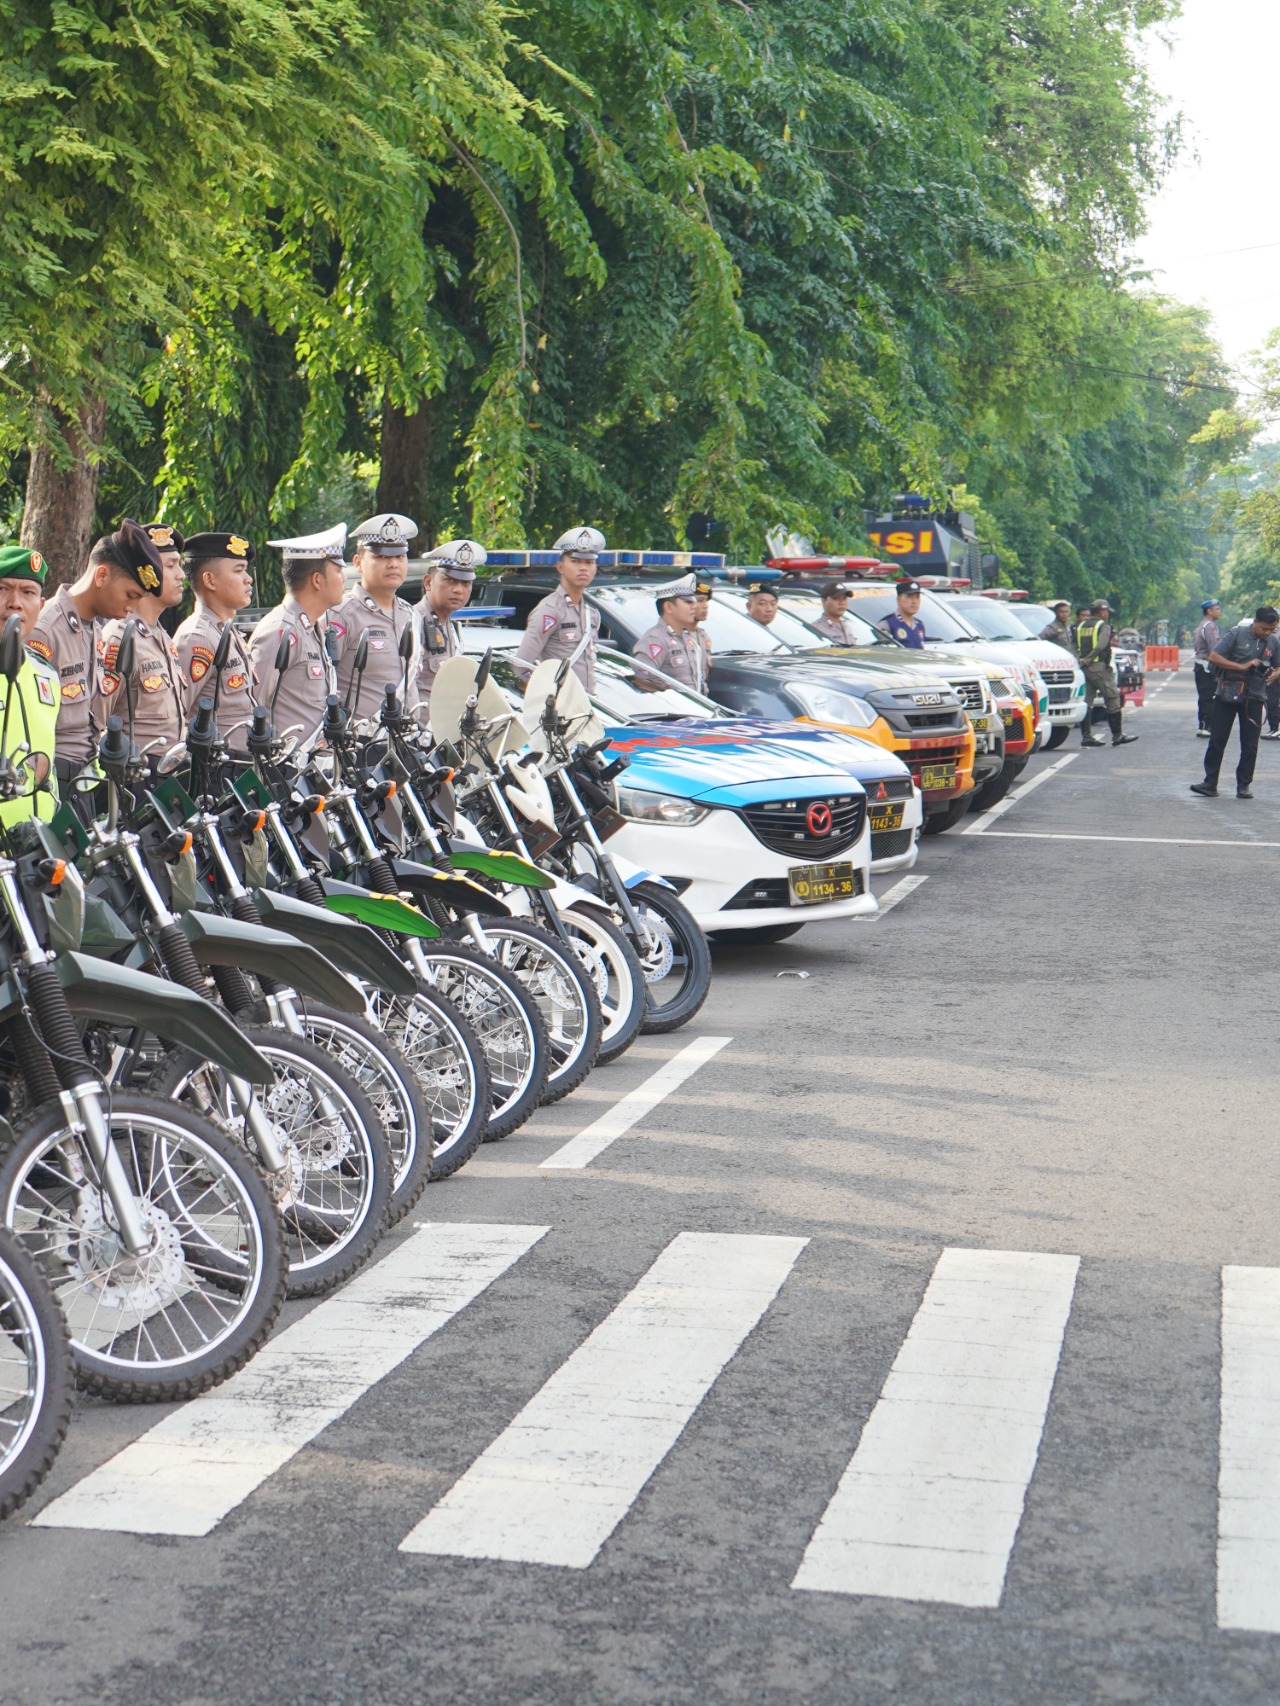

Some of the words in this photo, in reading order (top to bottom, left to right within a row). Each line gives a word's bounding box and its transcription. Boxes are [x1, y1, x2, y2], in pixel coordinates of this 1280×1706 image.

[912, 694, 940, 705] ISUZU
[886, 805, 893, 815] X
[829, 868, 835, 877] X
